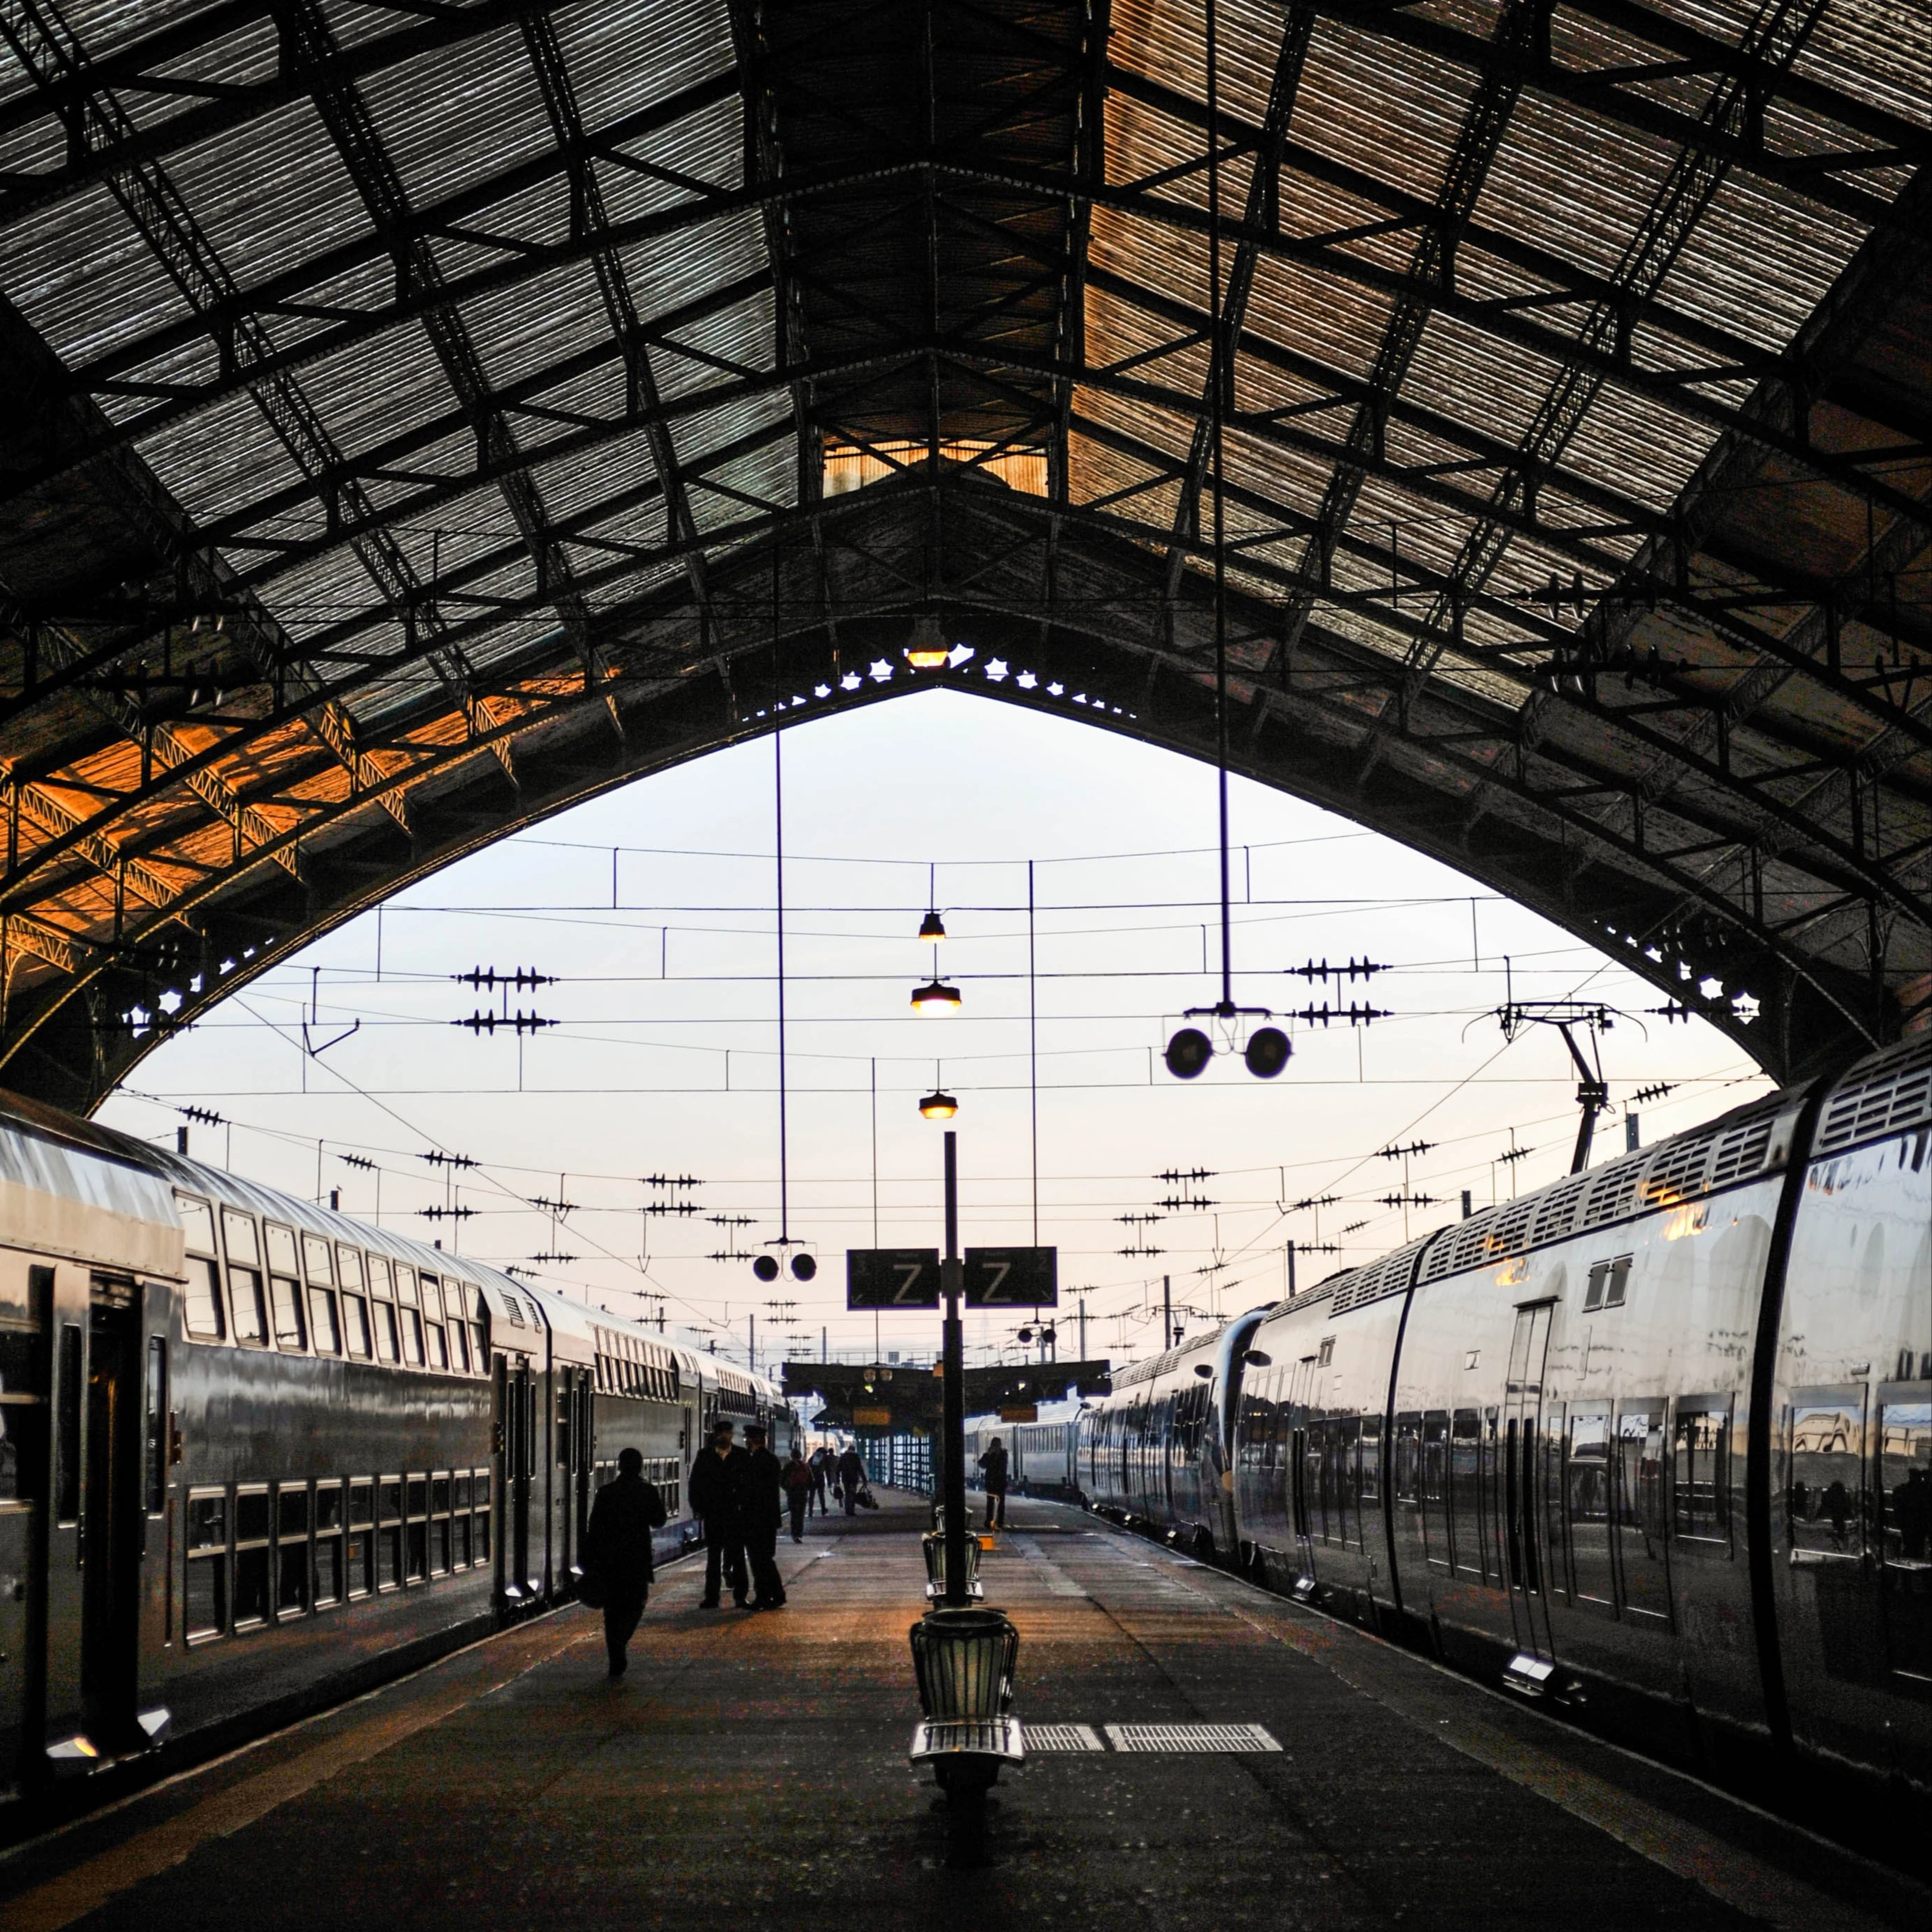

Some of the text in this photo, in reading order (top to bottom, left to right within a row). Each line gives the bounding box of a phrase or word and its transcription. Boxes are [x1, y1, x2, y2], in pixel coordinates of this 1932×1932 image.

[894, 1264, 922, 1304] Z
[982, 1262, 1011, 1303] Z
[842, 1388, 854, 1403] Y
